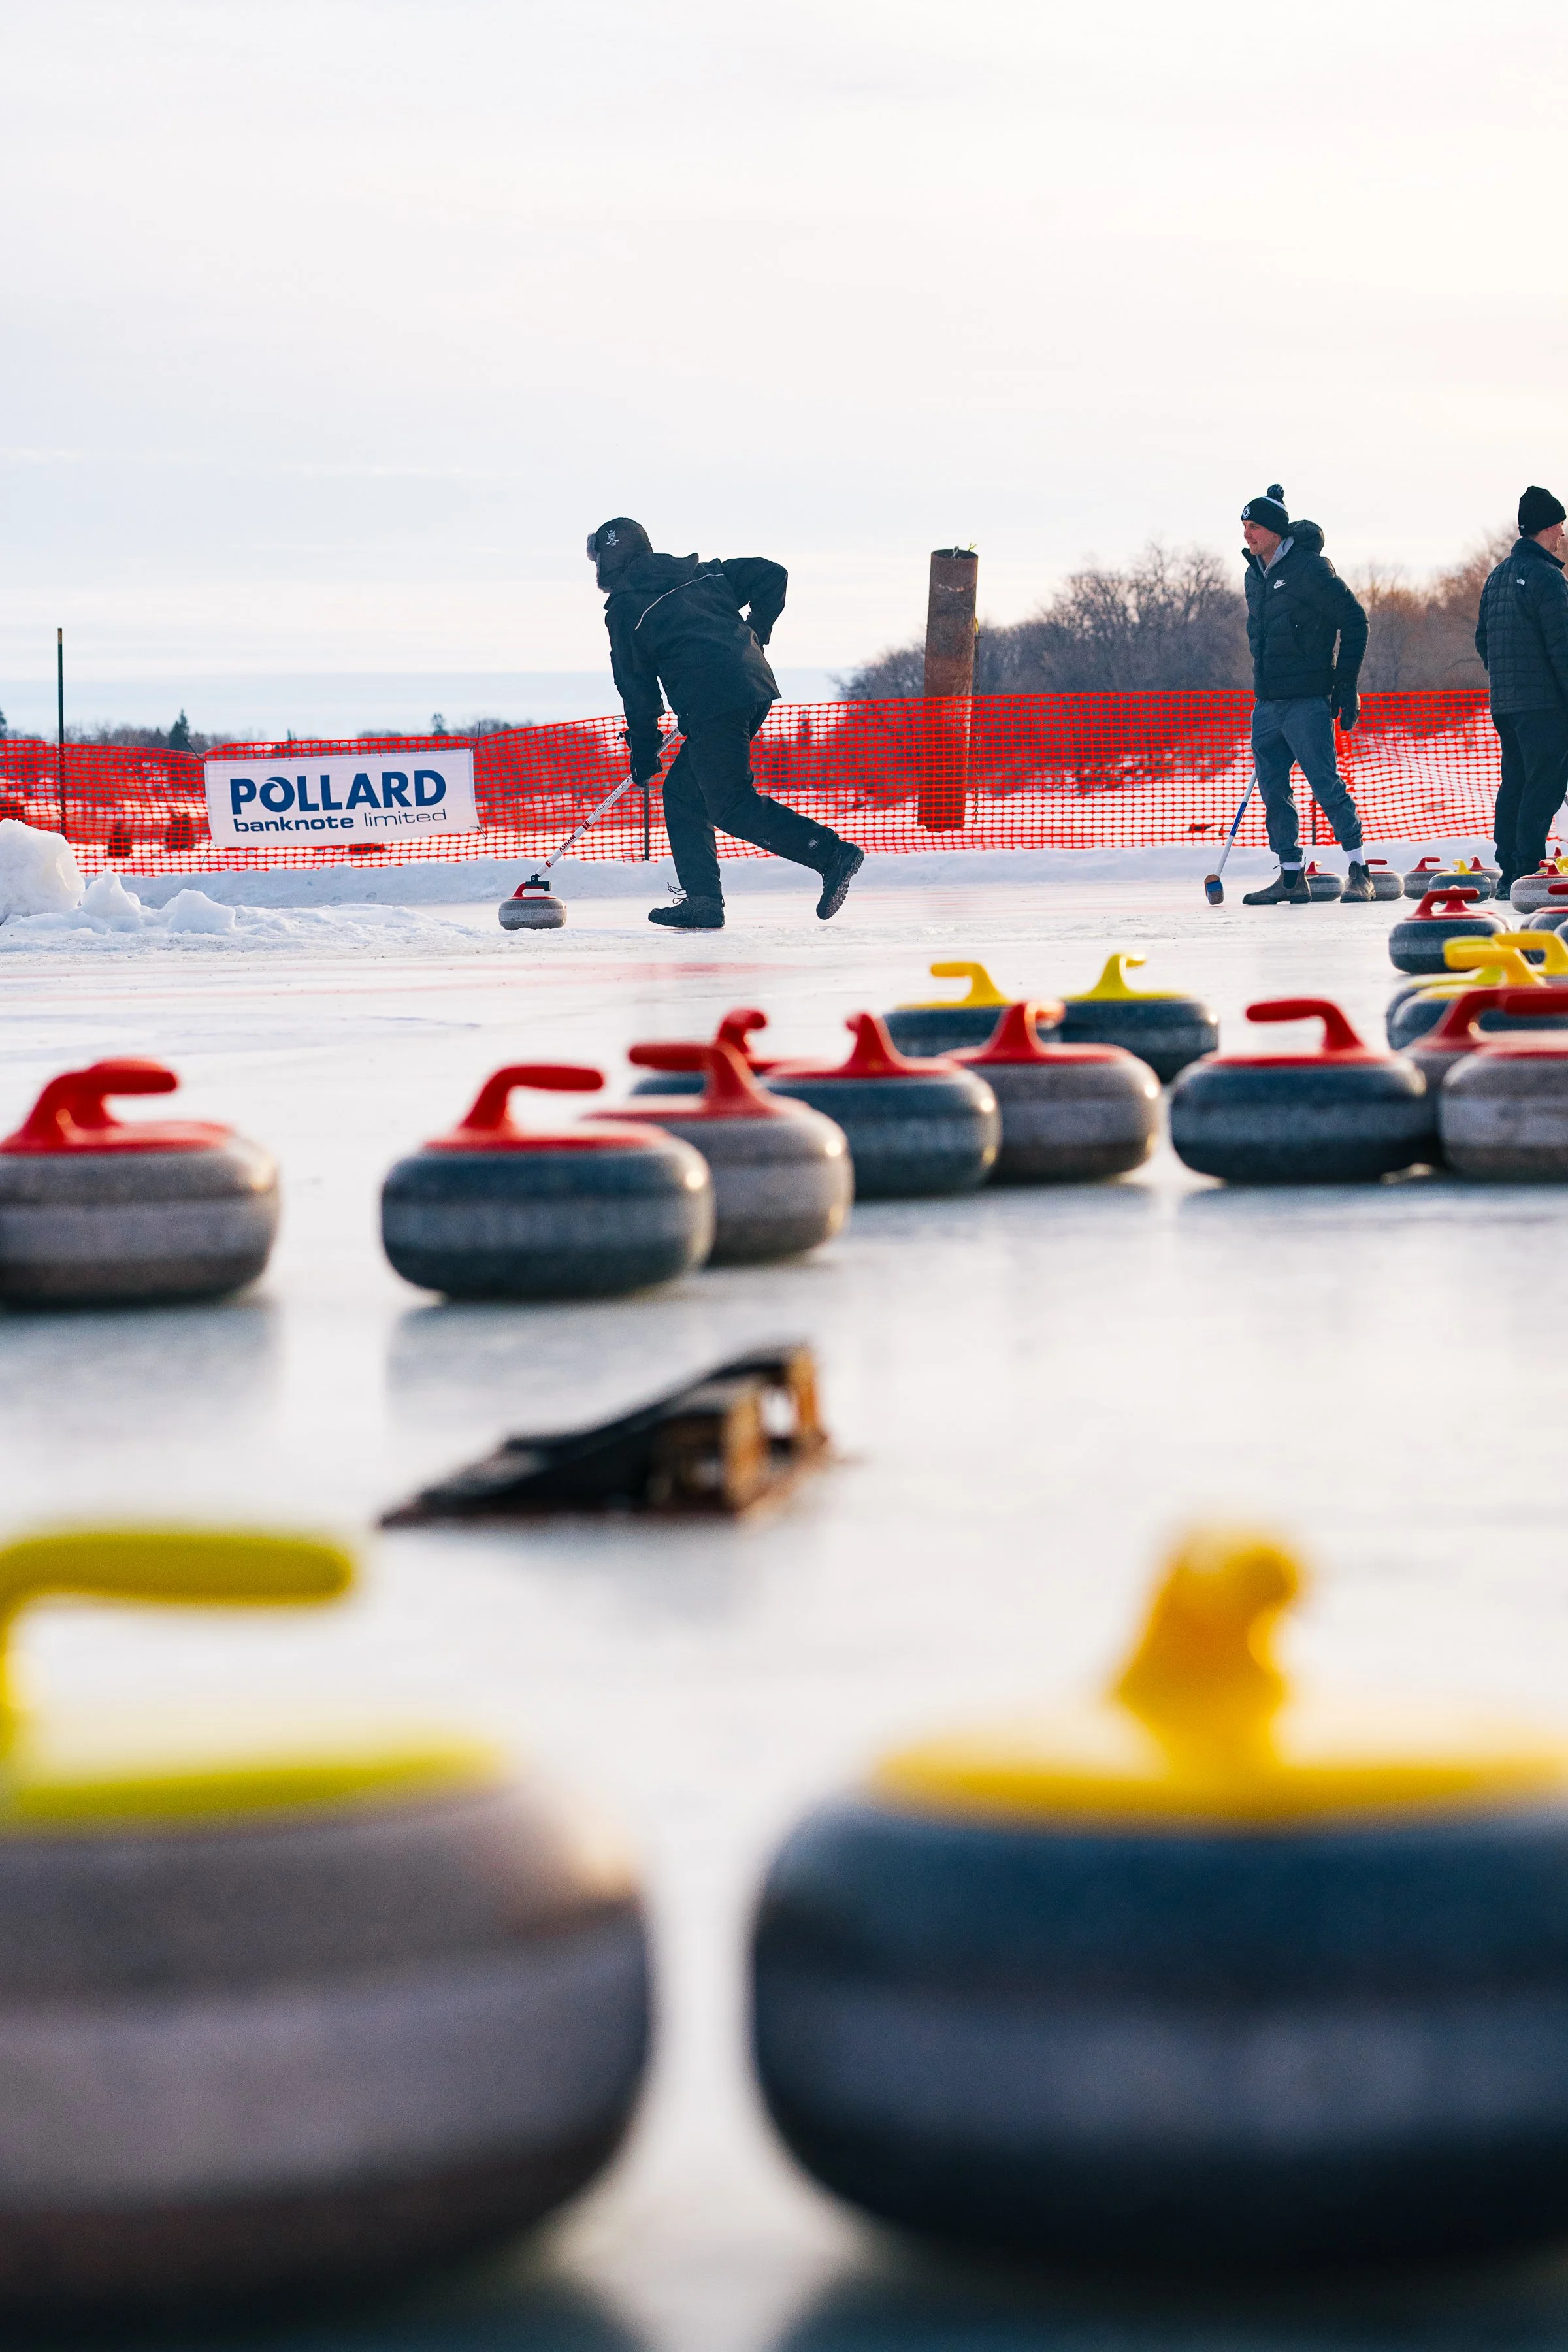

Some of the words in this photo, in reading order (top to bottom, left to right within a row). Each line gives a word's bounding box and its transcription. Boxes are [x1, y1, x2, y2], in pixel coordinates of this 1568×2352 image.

[229, 770, 446, 815] POLLARD
[233, 815, 354, 832] banknote
[364, 809, 447, 827] limited
[559, 834, 576, 852] ASHAM
